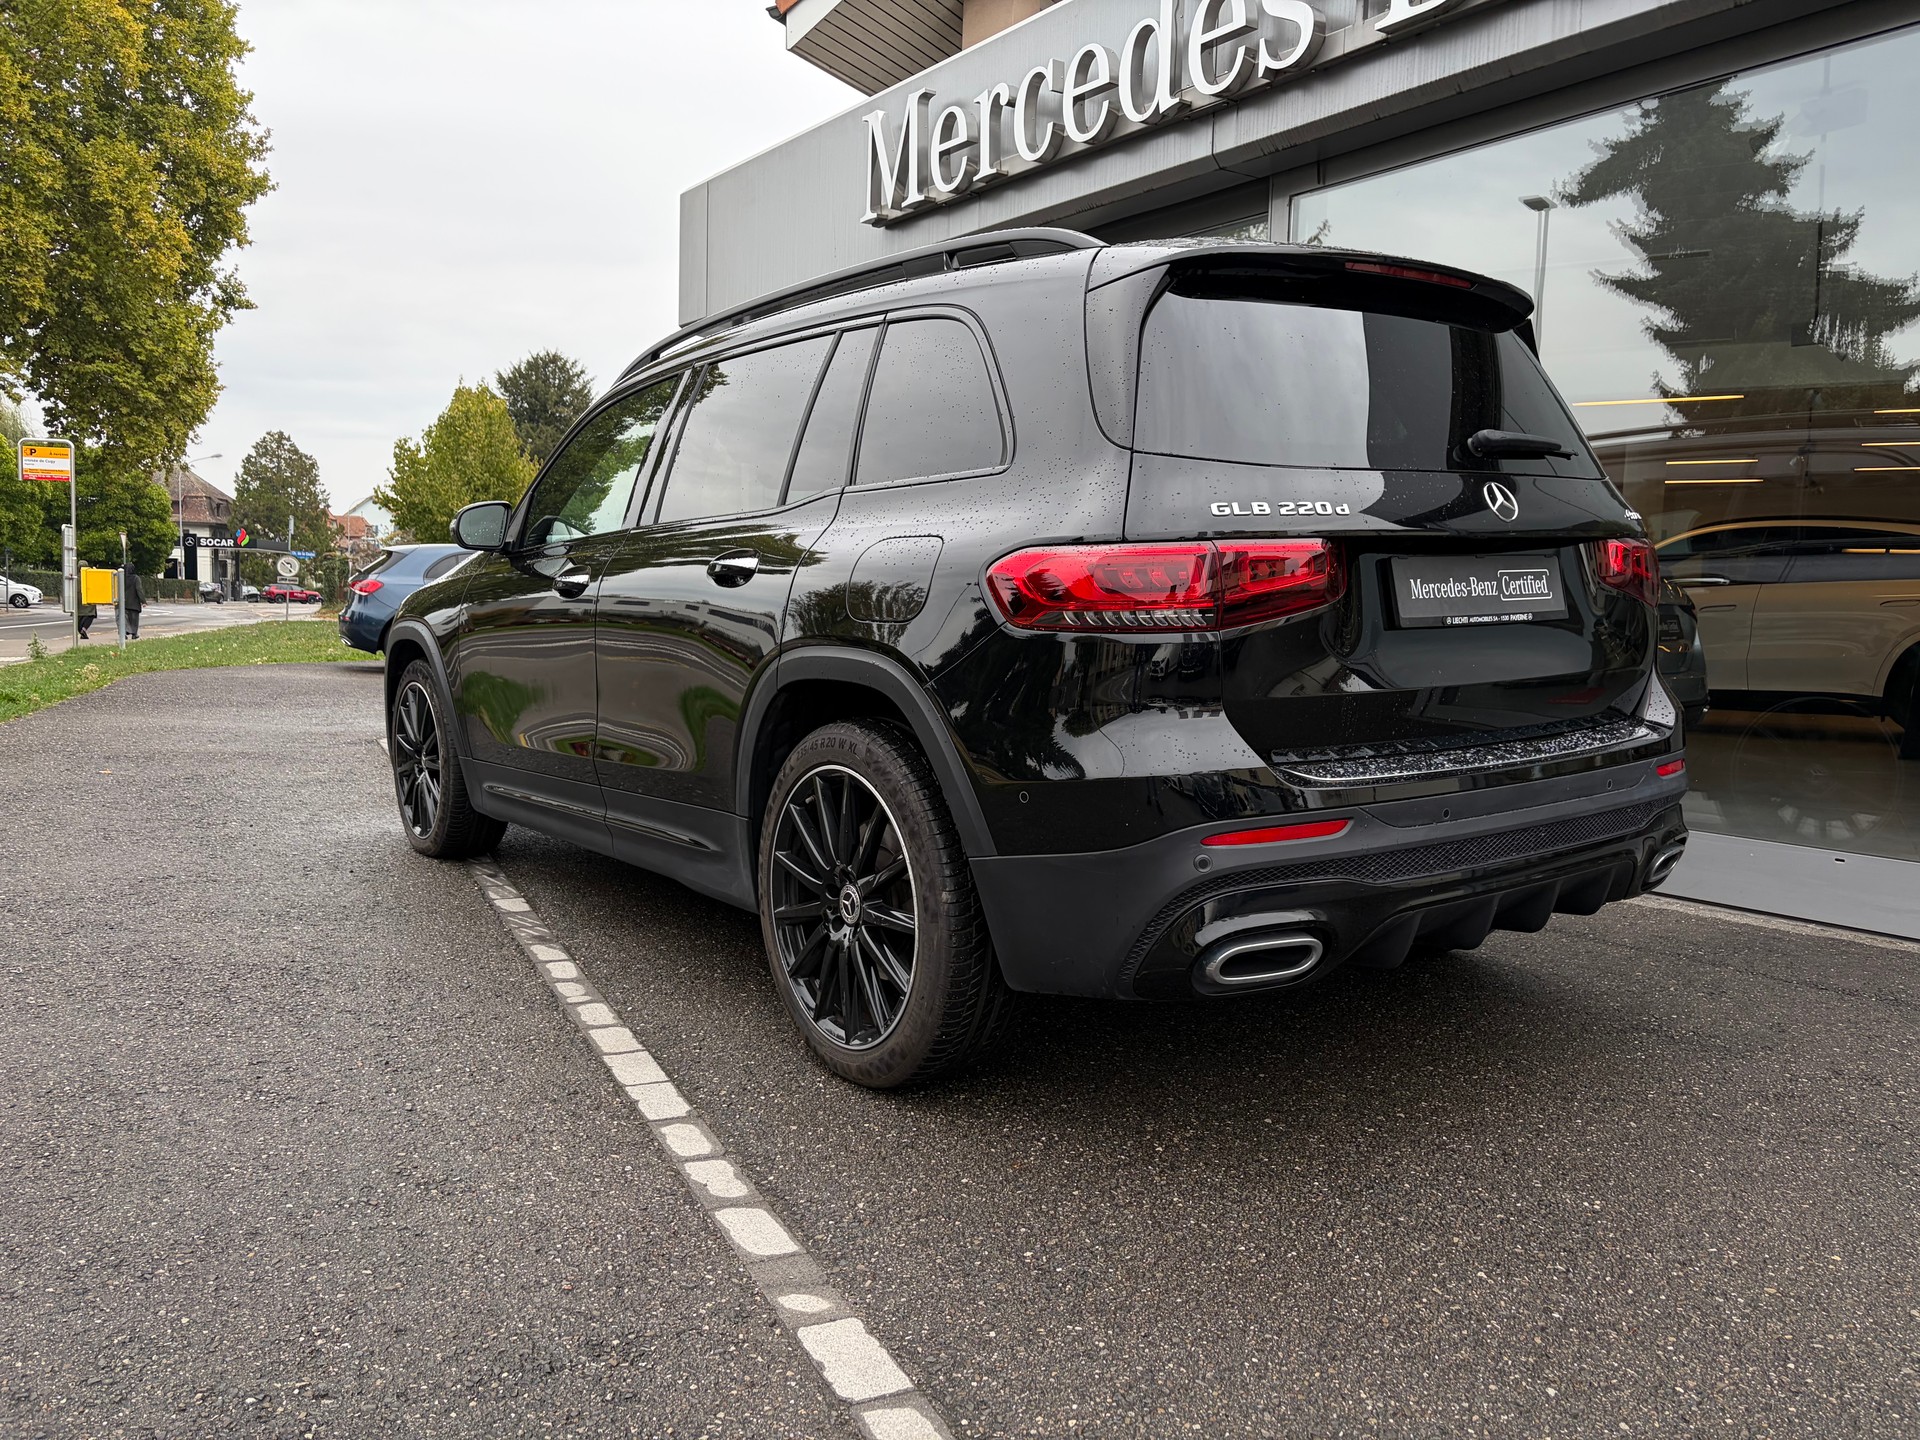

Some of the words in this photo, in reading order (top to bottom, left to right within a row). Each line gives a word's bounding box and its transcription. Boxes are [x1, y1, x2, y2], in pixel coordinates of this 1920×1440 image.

[1210, 501, 1271, 516] GLB
[200, 538, 235, 547] SOCAR
[1410, 576, 1499, 599] Mercedes-Benz
[1502, 575, 1549, 596] Certified
[820, 737, 836, 749] R20
[847, 740, 858, 755] XL
